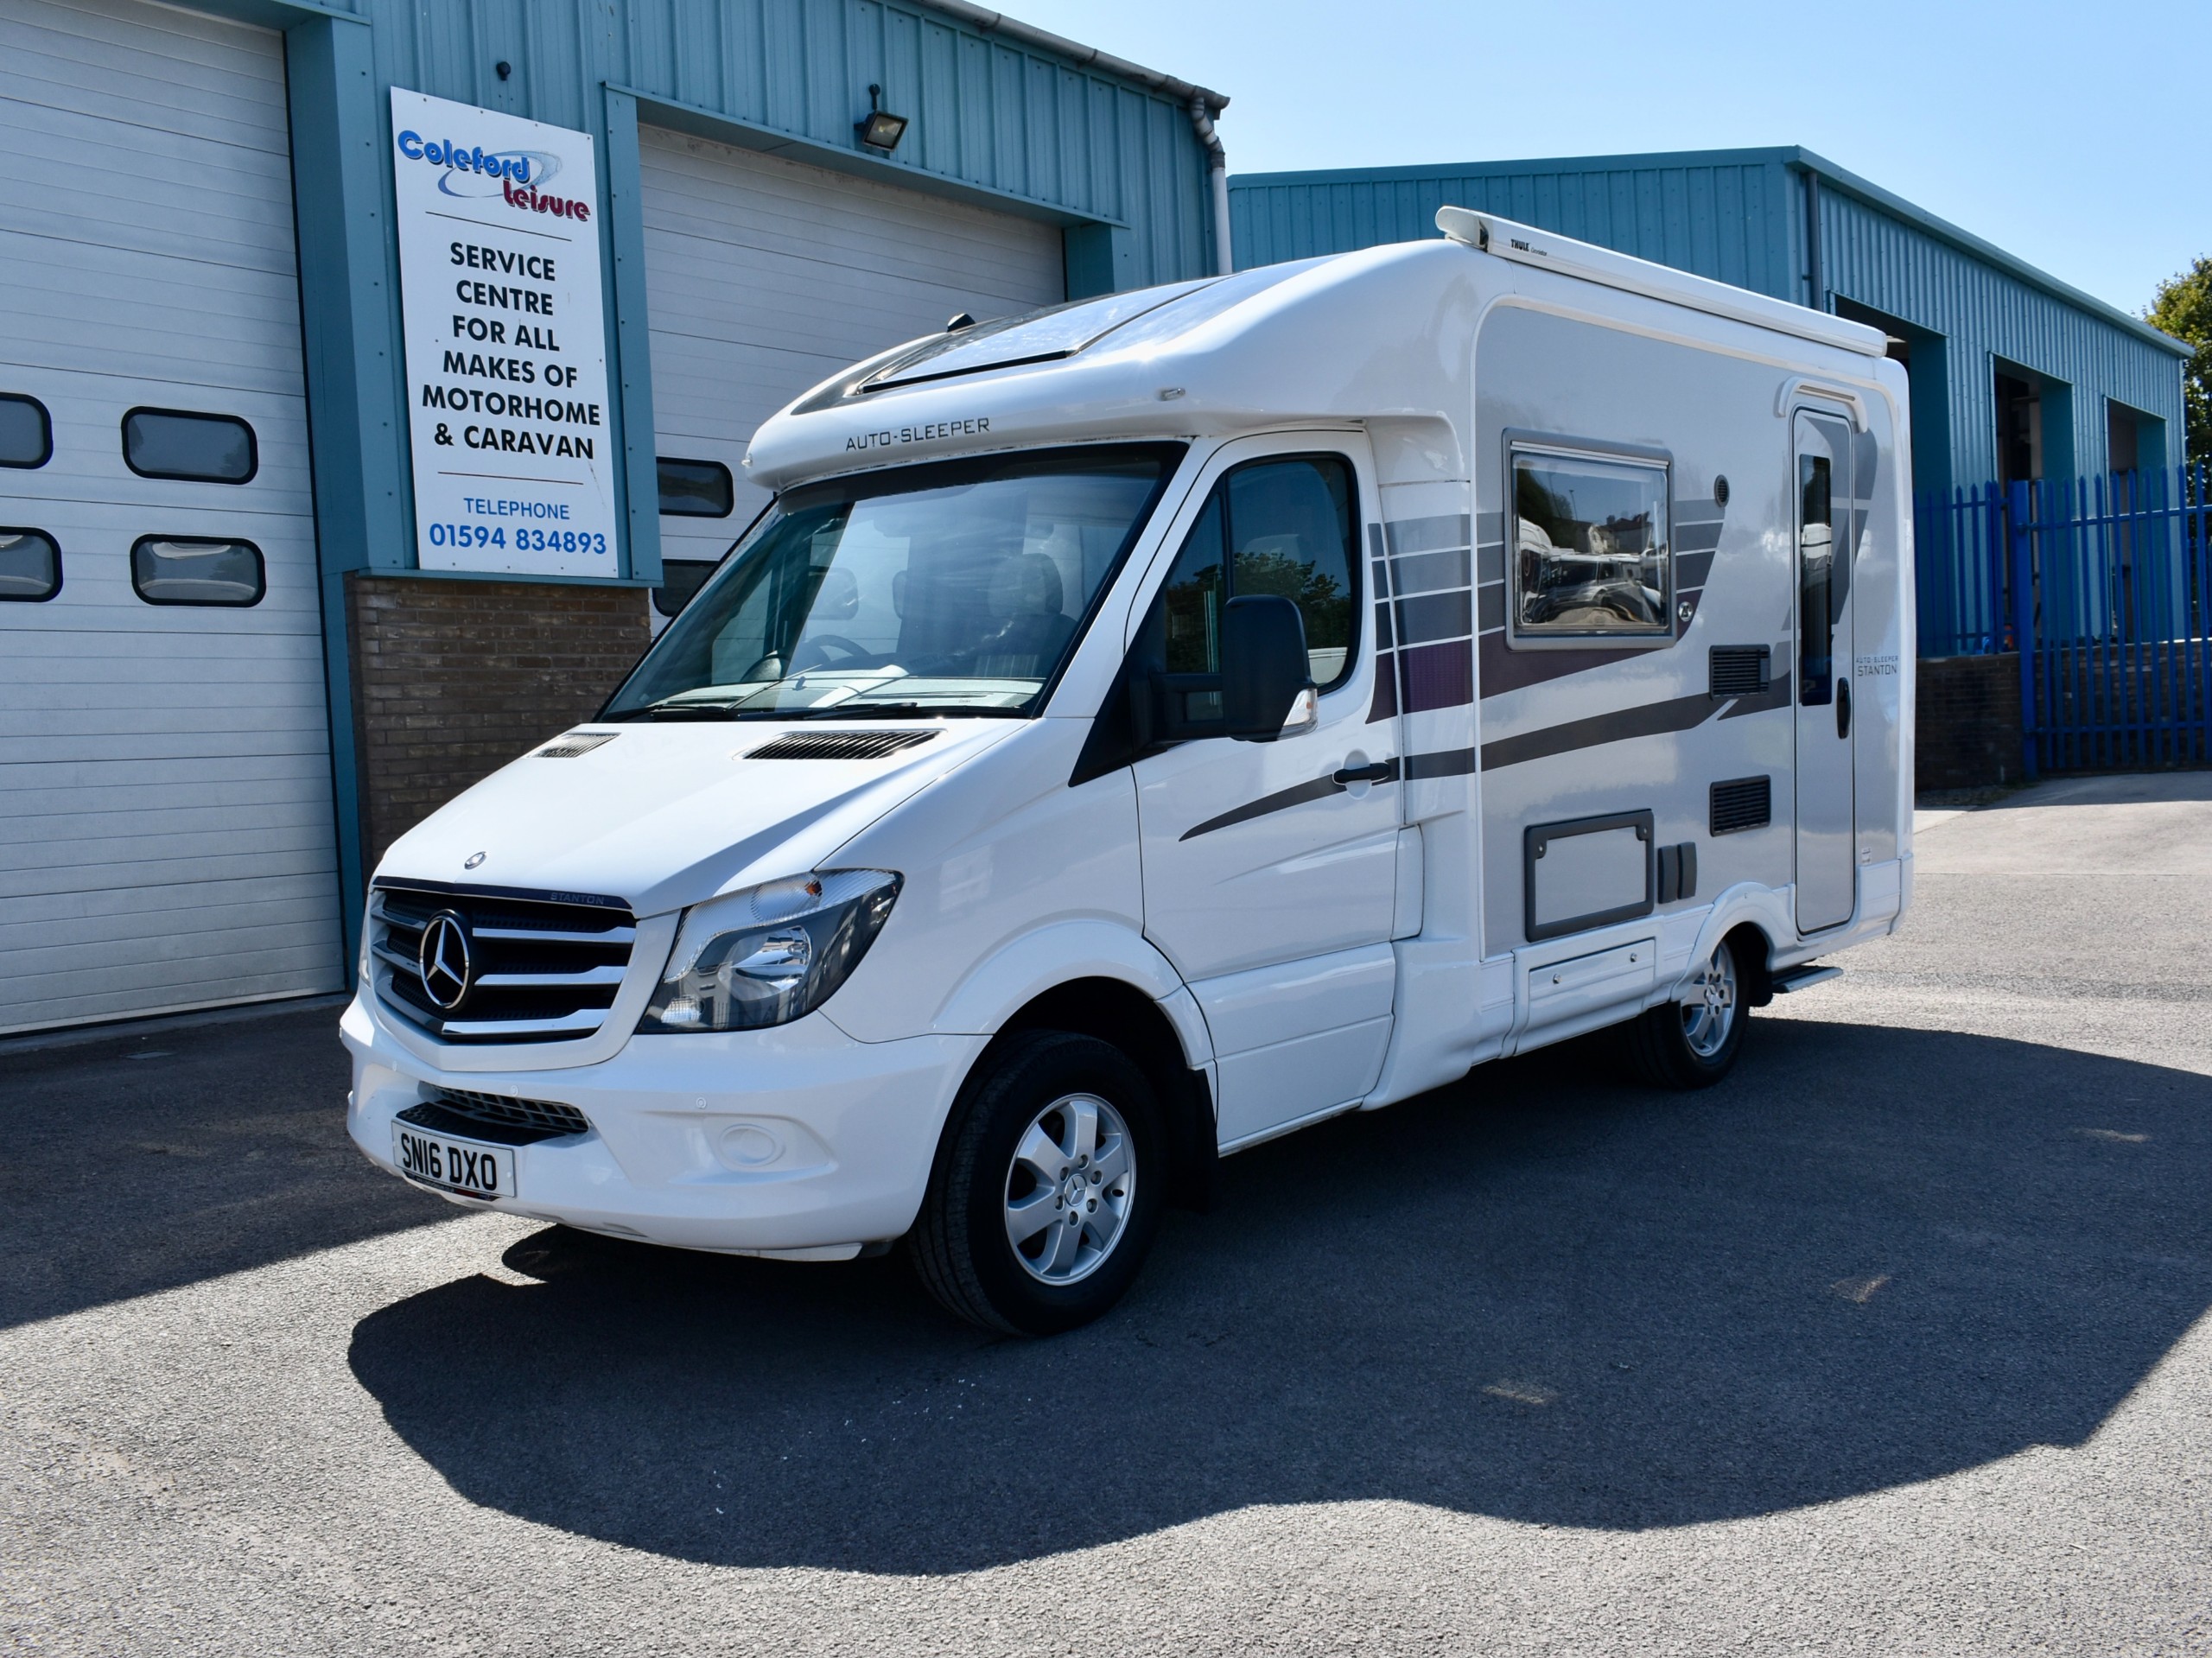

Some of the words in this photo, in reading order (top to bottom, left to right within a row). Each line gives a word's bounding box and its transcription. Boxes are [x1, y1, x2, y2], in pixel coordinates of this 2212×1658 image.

[397, 130, 530, 183] Coleford
[503, 180, 591, 222] Leisure
[450, 242, 556, 282] SERVICE
[1510, 238, 1529, 251] THULE
[456, 280, 554, 316] CENTRE
[453, 314, 506, 345] FOR
[514, 324, 560, 352] ALL
[443, 350, 536, 384] MAKES
[544, 364, 577, 388] OF
[422, 384, 601, 426] MOTORHOME
[434, 422, 454, 447] &
[463, 425, 594, 460] CARAVAN
[845, 417, 990, 452] AUTO-SLEEPER
[463, 497, 570, 520] TELEPHONE
[429, 523, 506, 549] 01594
[515, 528, 607, 555] 834893
[1857, 664, 1898, 677] STANTON
[550, 892, 605, 905] STANTON
[400, 1132, 442, 1178] SN16
[447, 1146, 498, 1191] DXO
